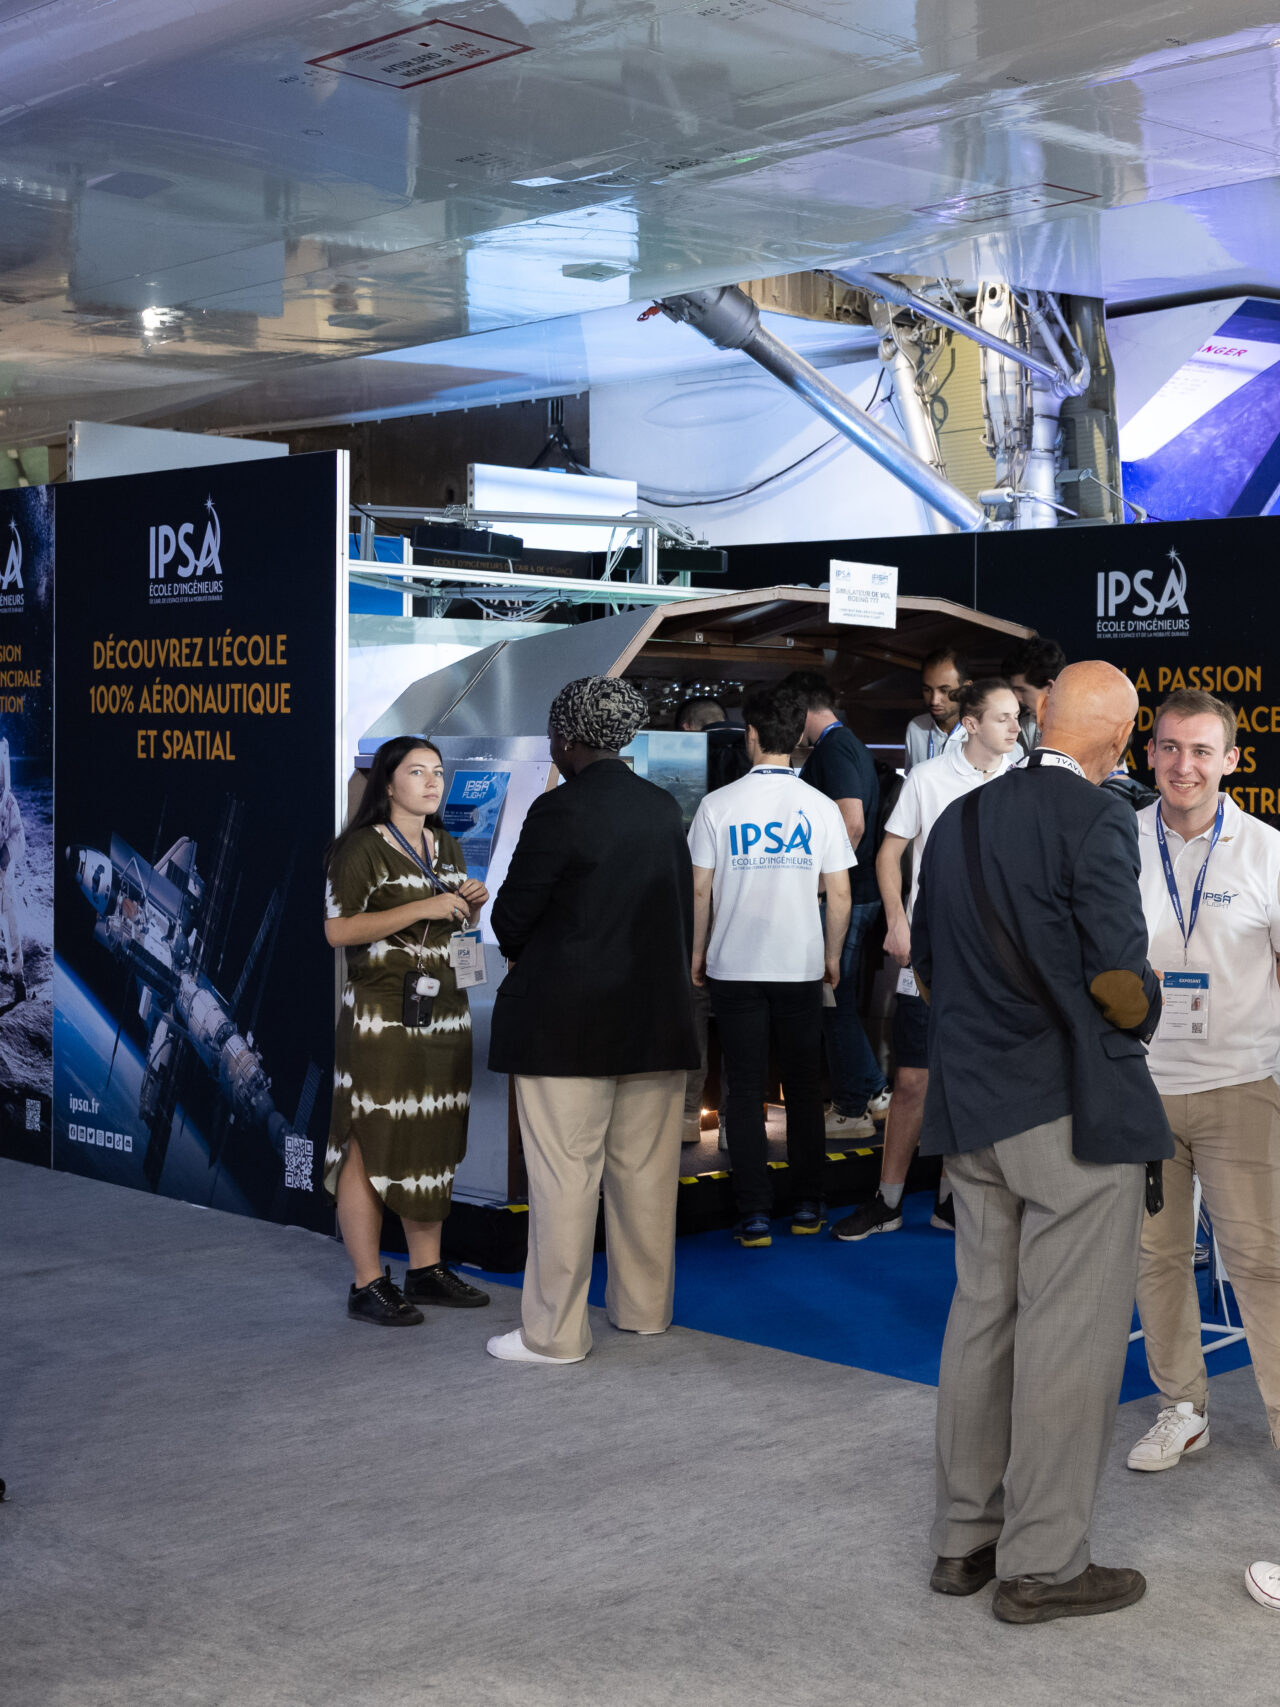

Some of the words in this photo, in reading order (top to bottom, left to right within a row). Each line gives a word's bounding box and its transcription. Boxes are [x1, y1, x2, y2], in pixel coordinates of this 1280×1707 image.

[149, 521, 223, 579] IPSA
[149, 582, 172, 597] ÉCOLE
[173, 579, 224, 595] D'INGÉNIEURS
[1097, 568, 1190, 617] IPSA
[1097, 619, 1126, 632] ÉCOLE
[1128, 617, 1190, 631] D'INGÉNIEURS
[93, 633, 203, 670] DÉCOUVREZ
[208, 628, 287, 667] L'ÉCOLE
[1158, 665, 1262, 692] PASSION
[89, 685, 135, 714] 100%
[138, 677, 291, 715] AÉRONAUTIQUE
[137, 730, 157, 759] ET
[162, 730, 236, 760] SPATIAL
[729, 821, 812, 856] IPSA
[1202, 891, 1232, 904] IPSA
[69, 1092, 100, 1115] ipsa.fr
